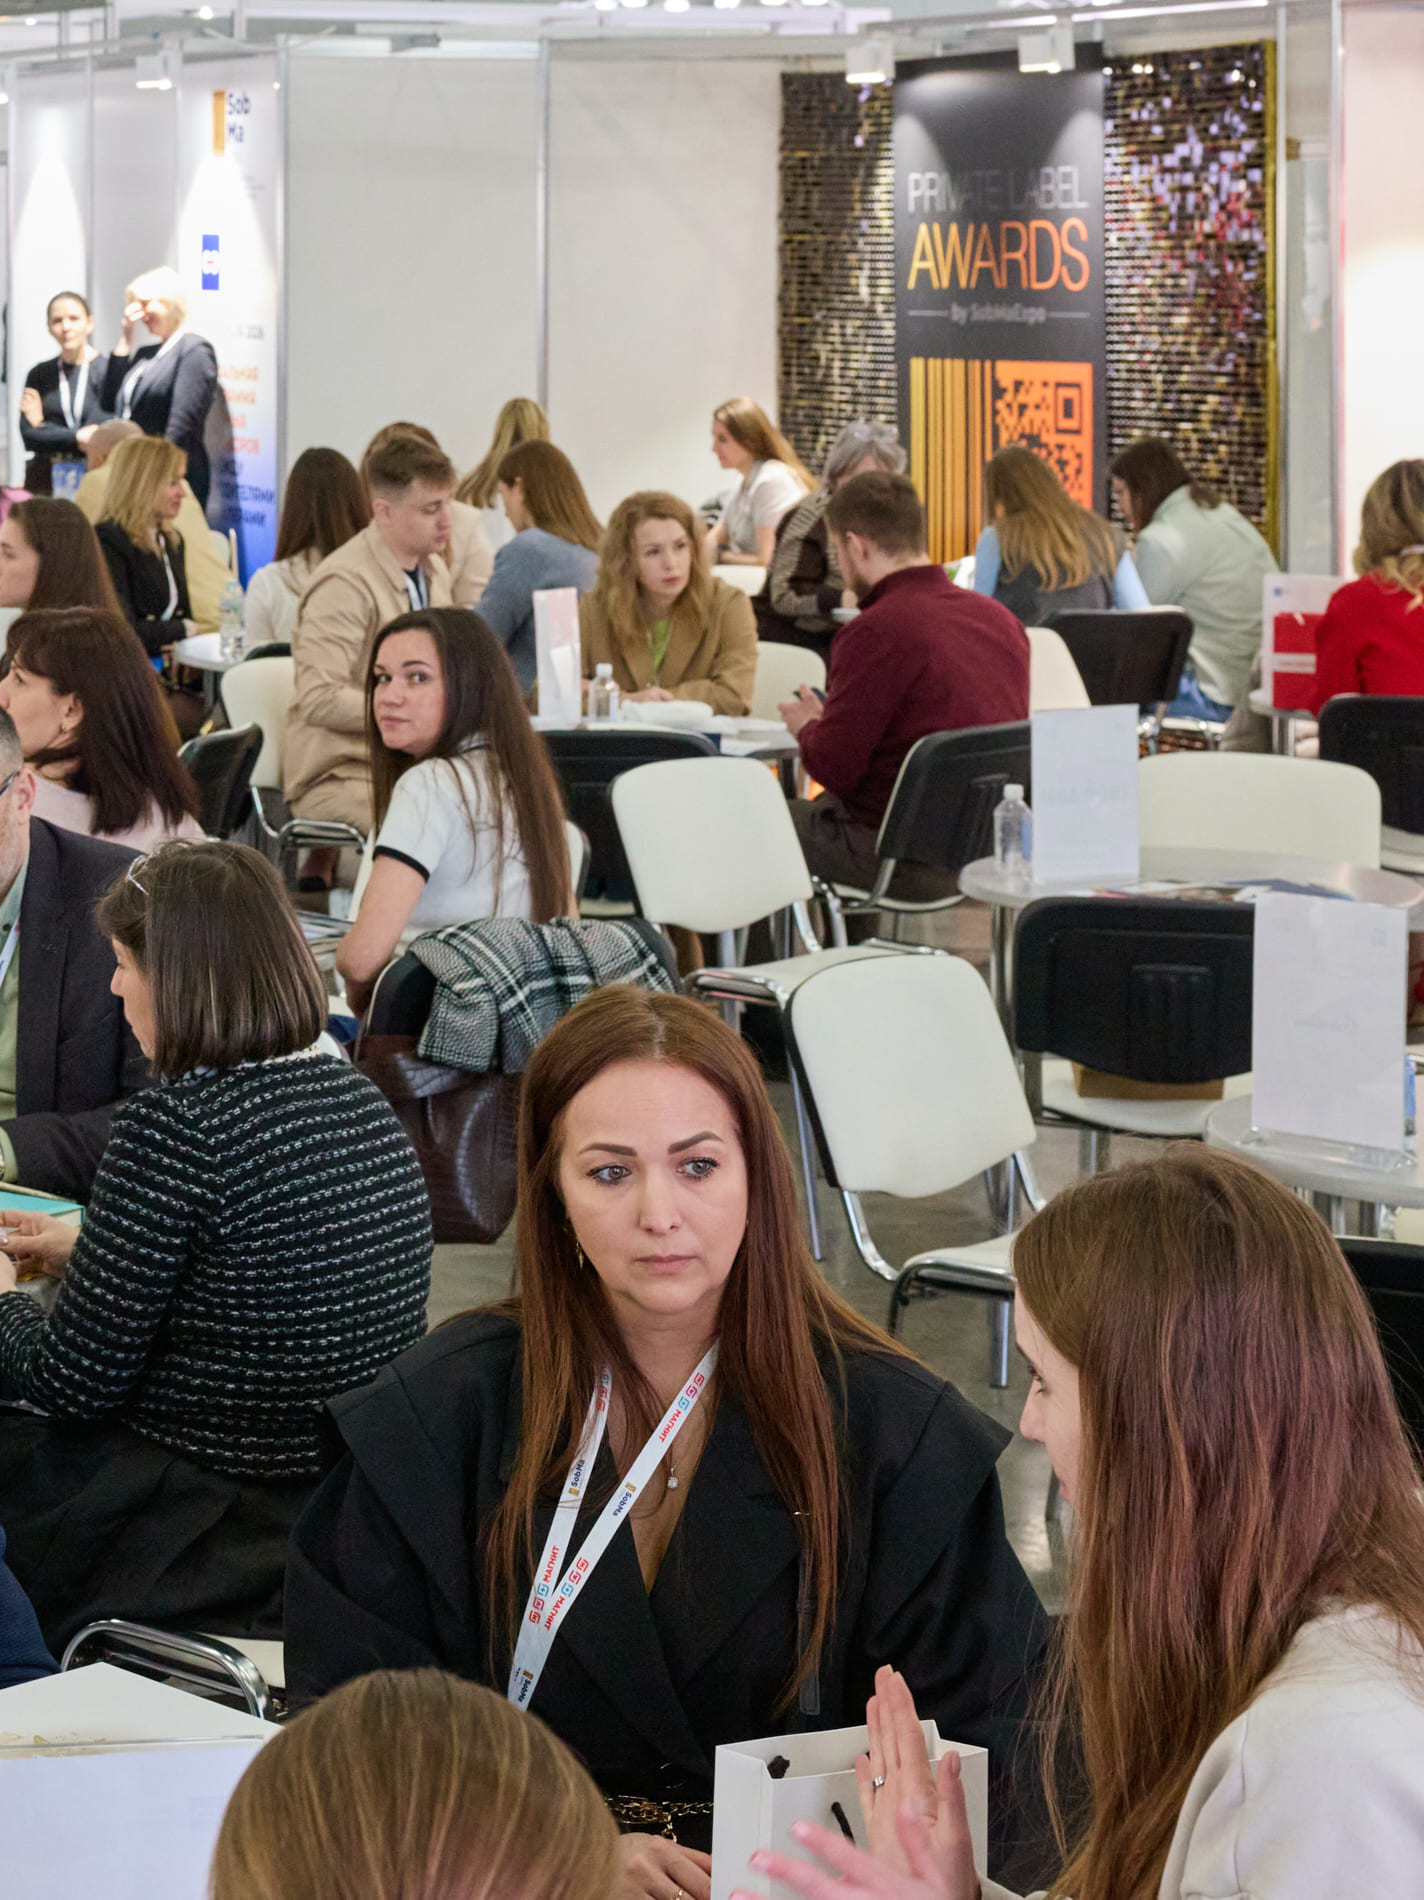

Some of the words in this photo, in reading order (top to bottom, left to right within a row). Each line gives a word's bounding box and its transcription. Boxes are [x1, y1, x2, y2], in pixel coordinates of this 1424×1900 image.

[907, 216, 1090, 292] AWARDS
[658, 1409, 682, 1443] МАГНИТ
[571, 1459, 586, 1488] SobMa
[612, 1491, 632, 1517] SobMa
[542, 1545, 560, 1583] МАГНИТ
[544, 1595, 566, 1631] МАГНИТ
